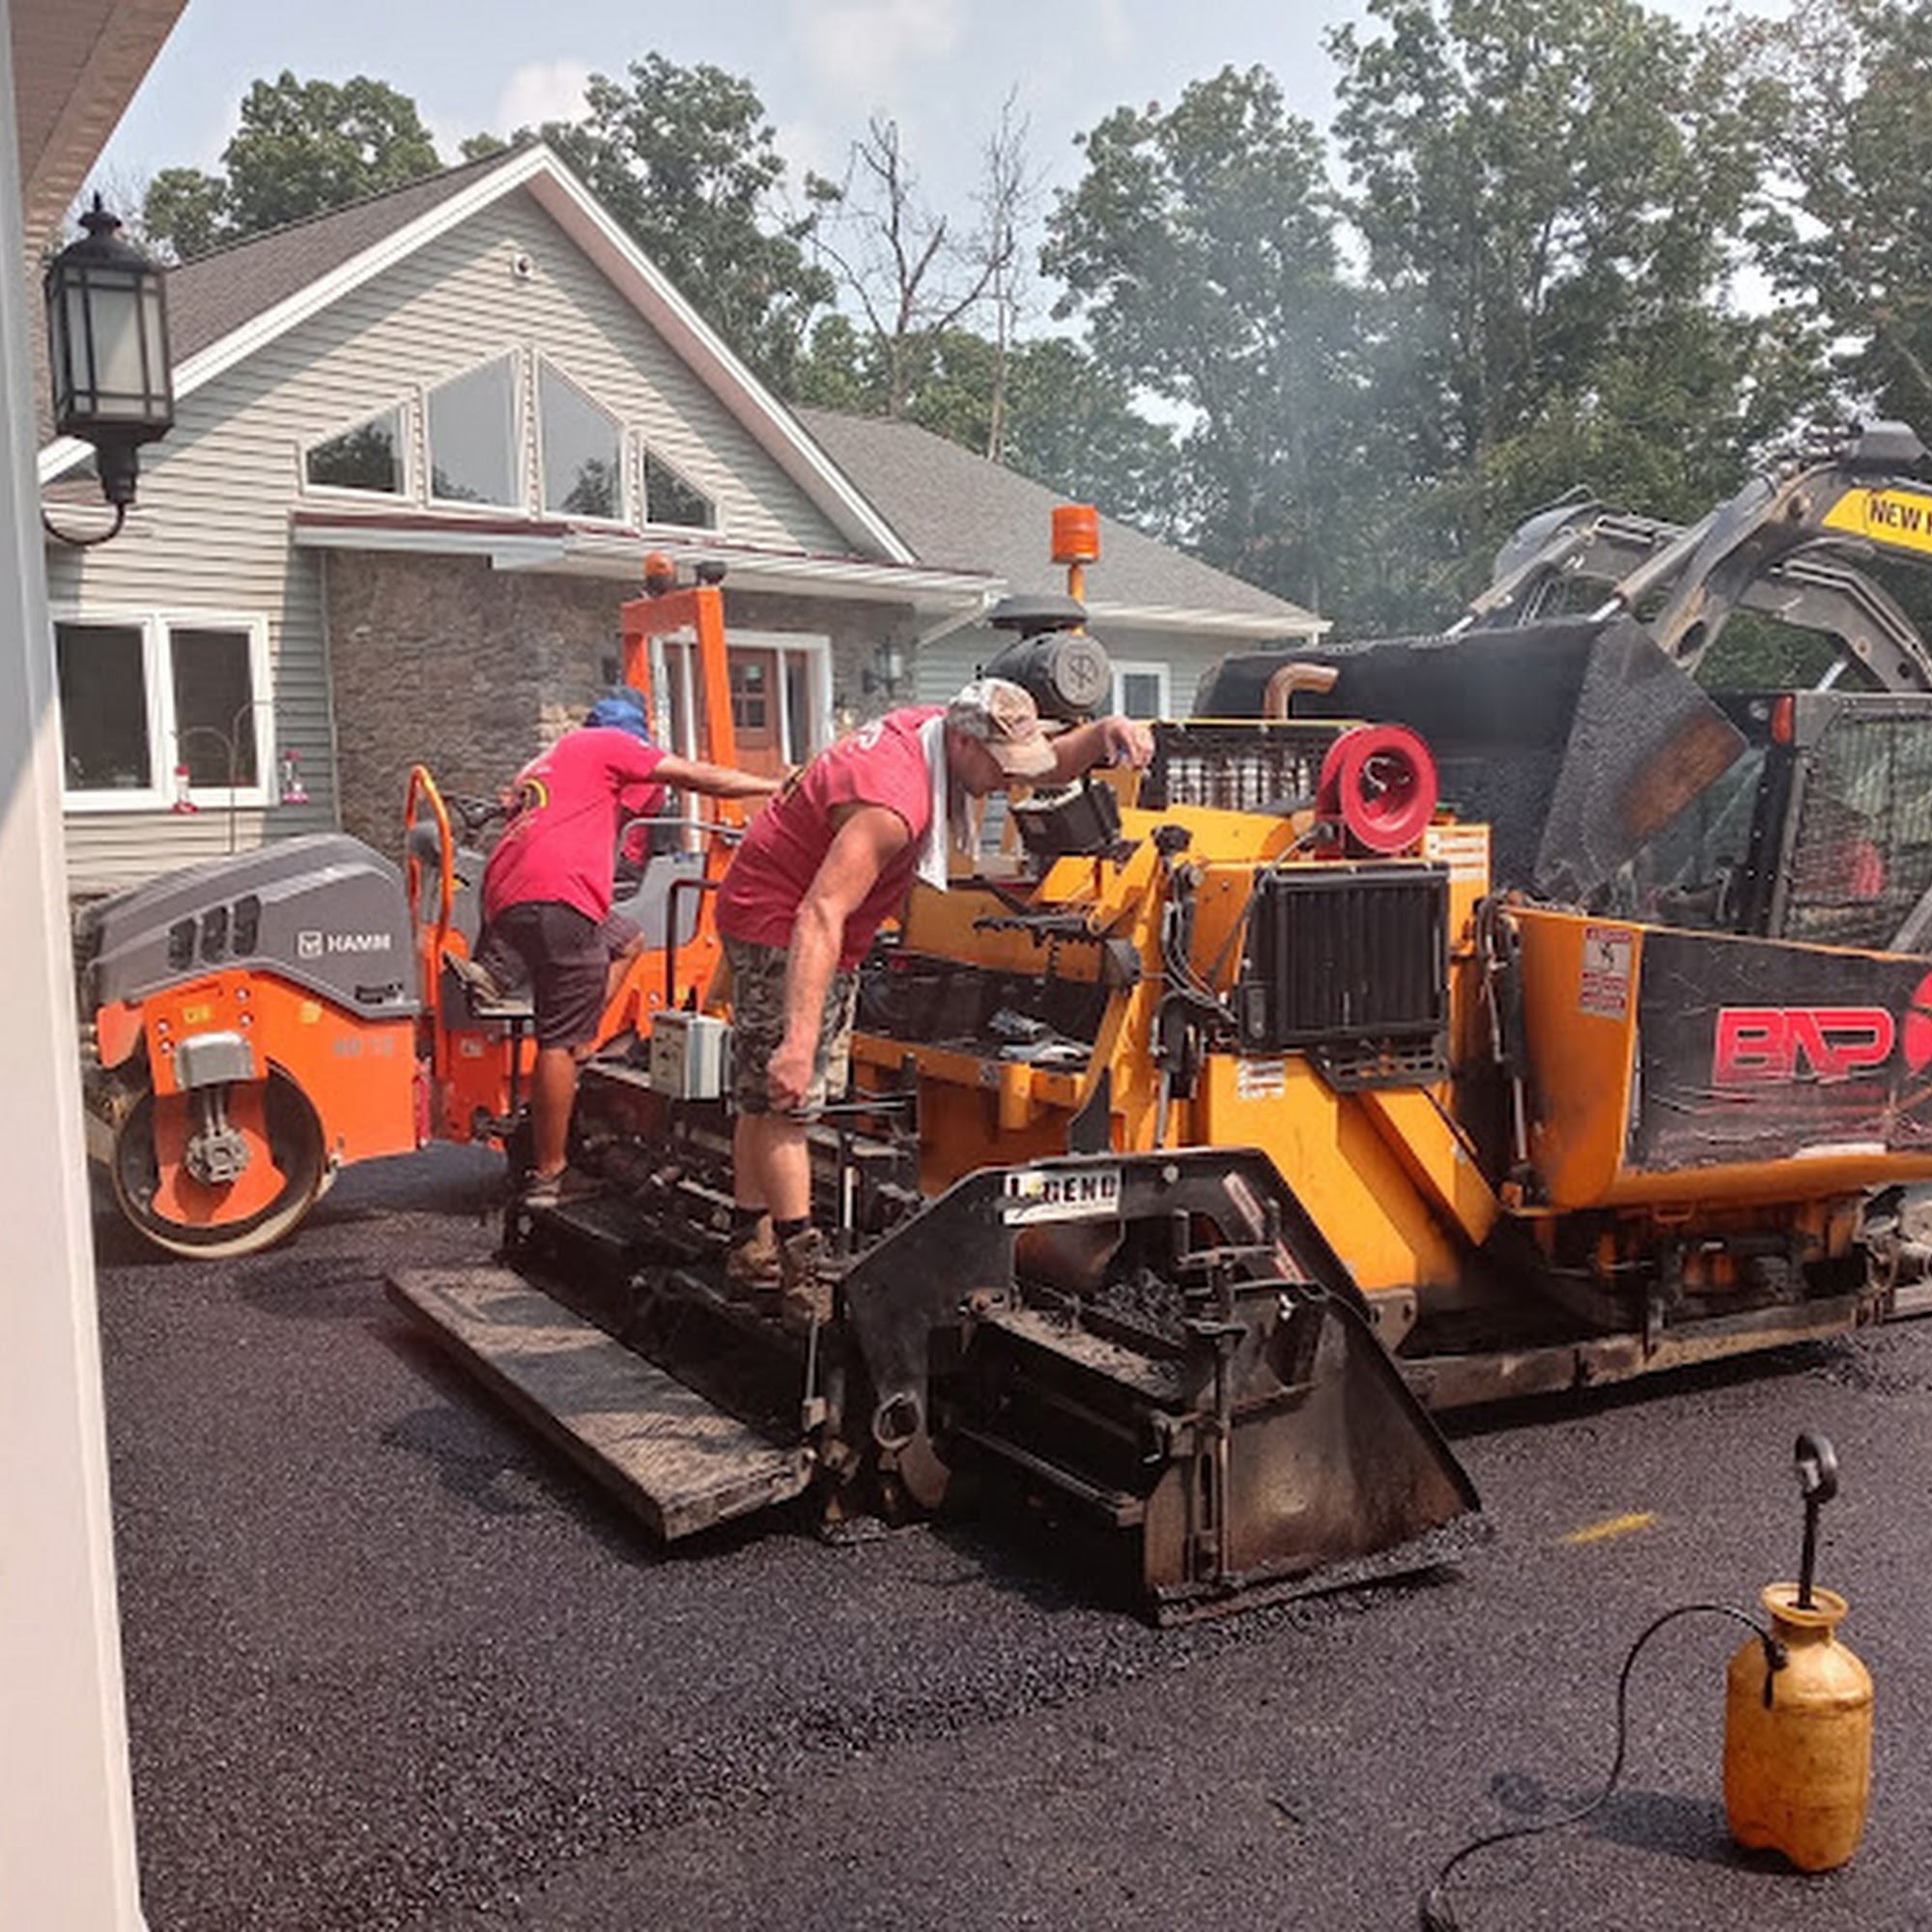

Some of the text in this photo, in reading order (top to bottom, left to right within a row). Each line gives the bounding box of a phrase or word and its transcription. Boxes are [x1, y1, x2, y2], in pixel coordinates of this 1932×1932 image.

[1870, 498, 1921, 530] NEW
[327, 934, 391, 952] HAMM
[1009, 1176, 1117, 1203] LGEND
